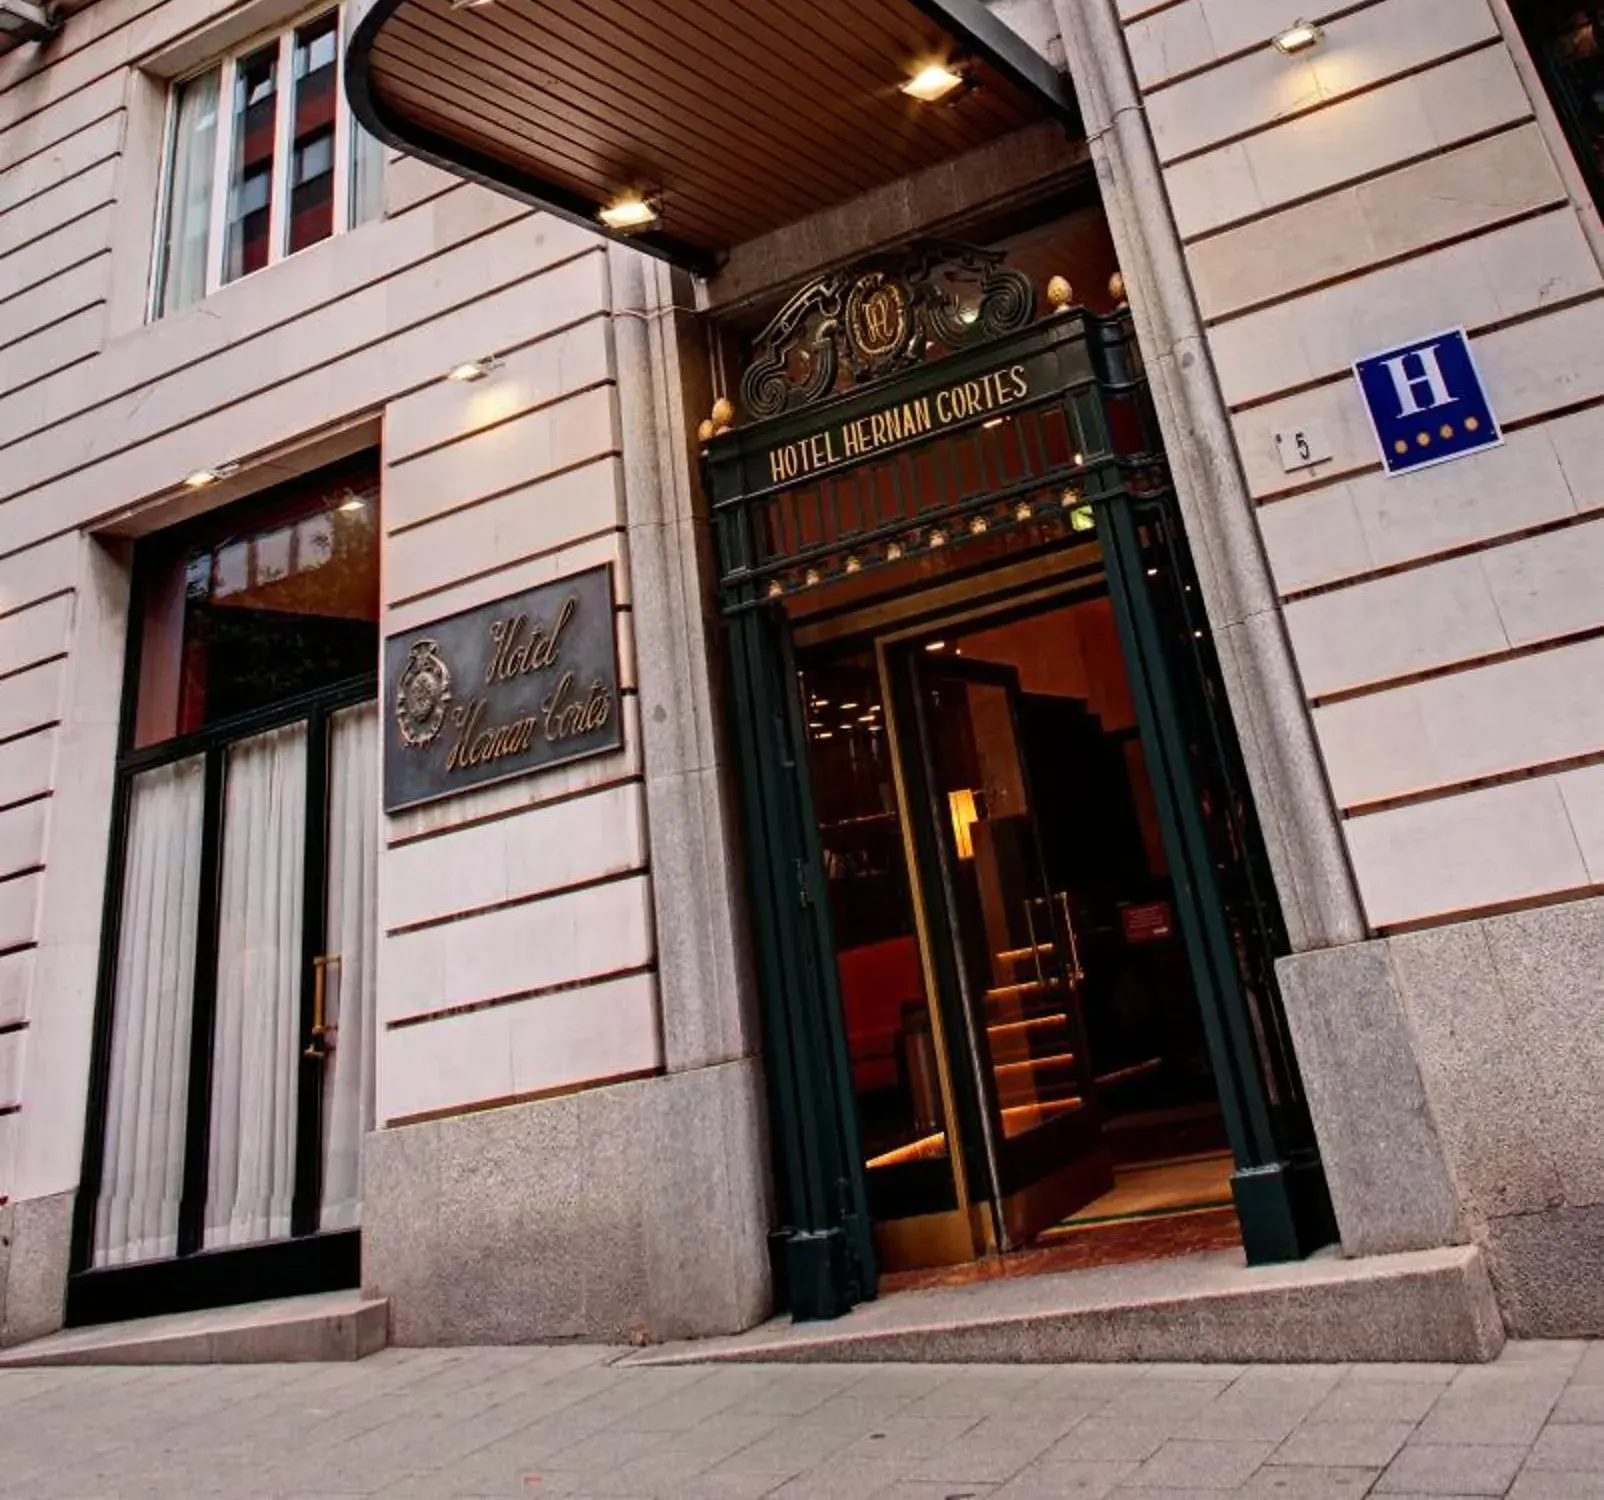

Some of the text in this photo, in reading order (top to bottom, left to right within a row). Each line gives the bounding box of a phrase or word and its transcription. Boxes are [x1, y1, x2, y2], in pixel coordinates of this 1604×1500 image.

[1379, 344, 1460, 418] H
[769, 365, 1028, 482] HOTEL HERNAN CORTES
[1295, 431, 1311, 460] 5
[485, 596, 577, 685] Hotel
